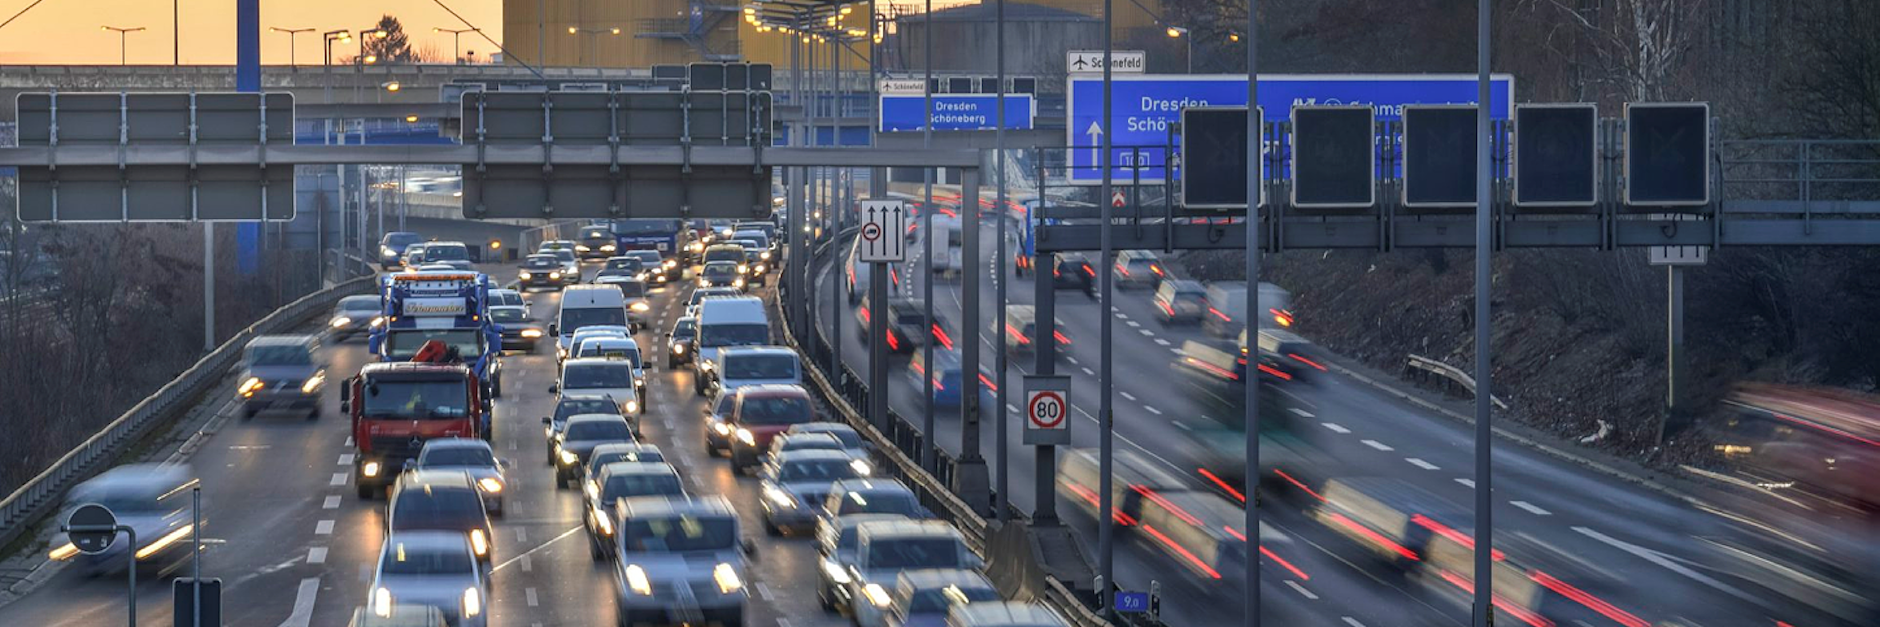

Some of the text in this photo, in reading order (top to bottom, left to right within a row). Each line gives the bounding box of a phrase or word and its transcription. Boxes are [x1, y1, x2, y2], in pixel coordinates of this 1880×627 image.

[1091, 56, 1141, 68] Scnefeld
[936, 101, 977, 111] Dresden
[1036, 401, 1058, 420] 80
[1124, 596, 1140, 609] 9,0
